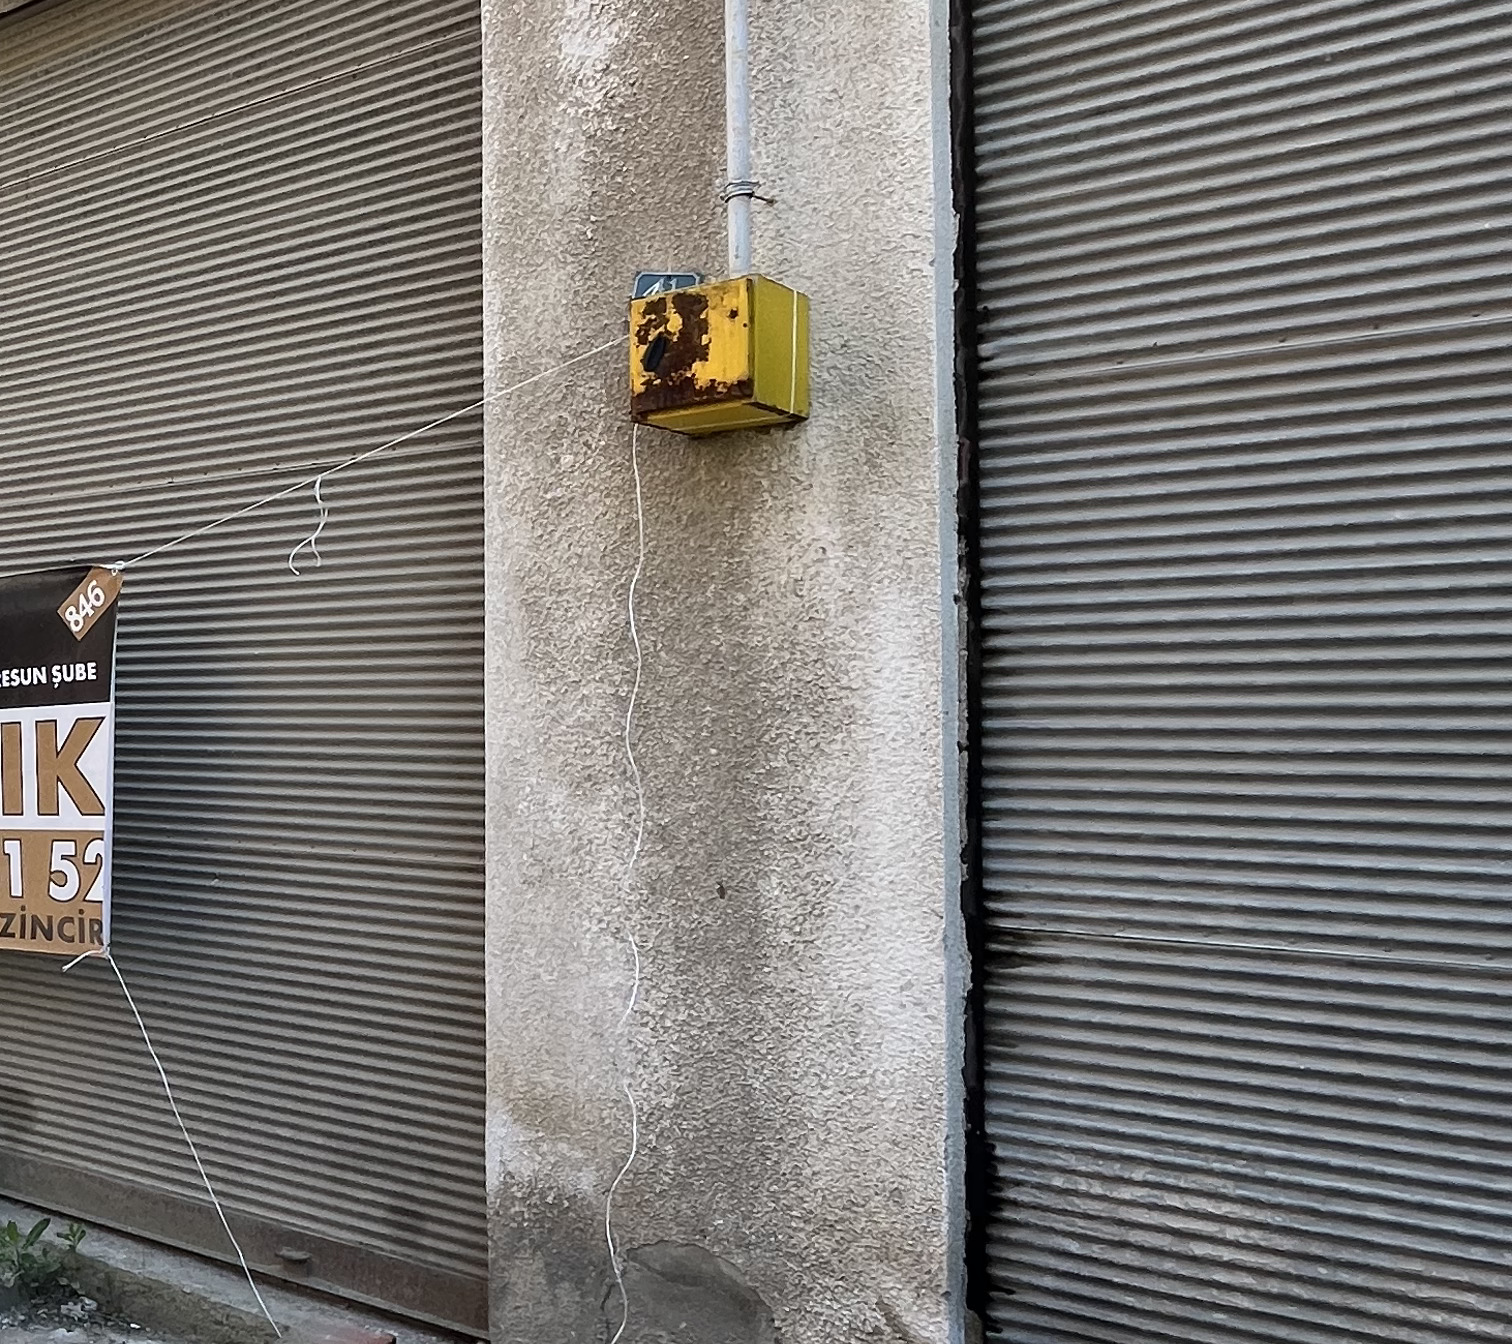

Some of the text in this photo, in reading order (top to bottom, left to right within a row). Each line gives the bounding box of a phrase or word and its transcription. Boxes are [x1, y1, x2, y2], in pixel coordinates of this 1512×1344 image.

[64, 579, 105, 632] 846
[51, 661, 97, 689] ŞUBE
[48, 837, 105, 903] 52
